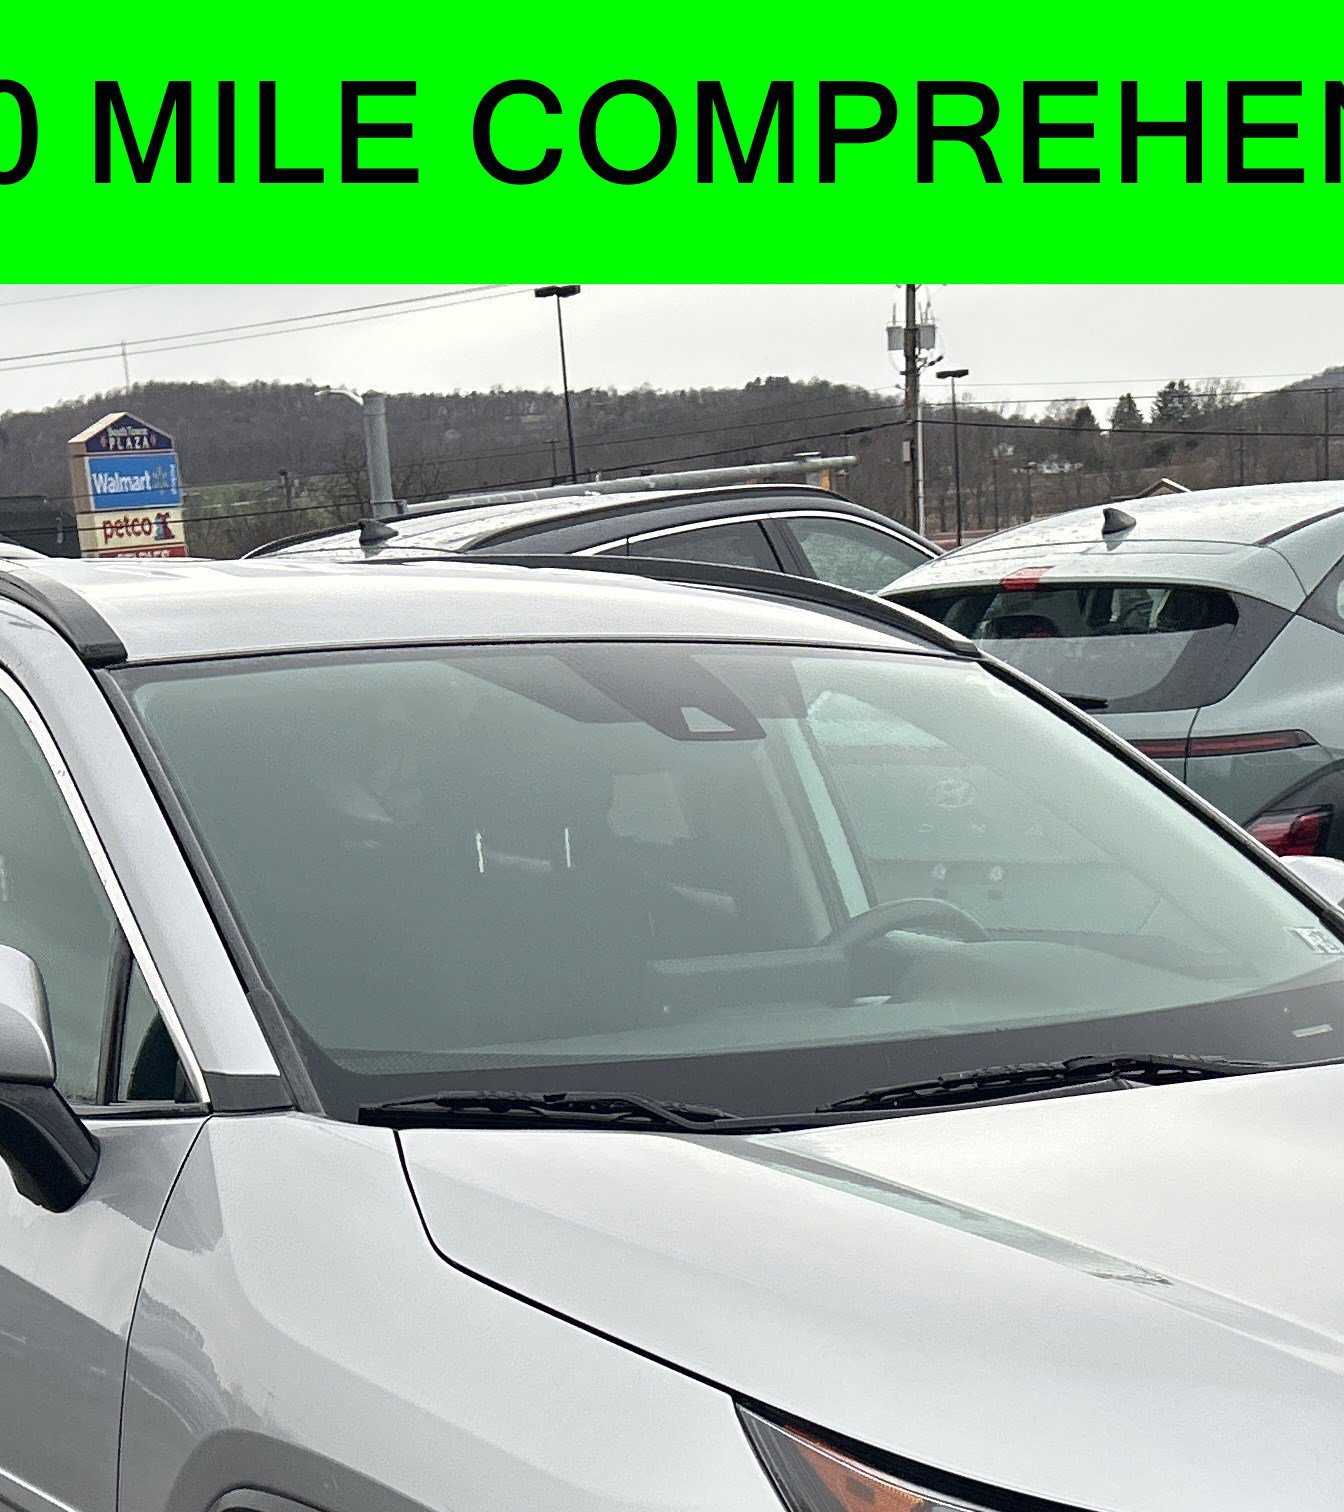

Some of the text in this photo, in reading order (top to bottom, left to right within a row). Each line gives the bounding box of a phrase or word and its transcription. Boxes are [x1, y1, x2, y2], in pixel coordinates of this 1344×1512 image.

[108, 436, 151, 450] PLAZA
[91, 470, 152, 494] Walmart
[102, 515, 152, 545] petco
